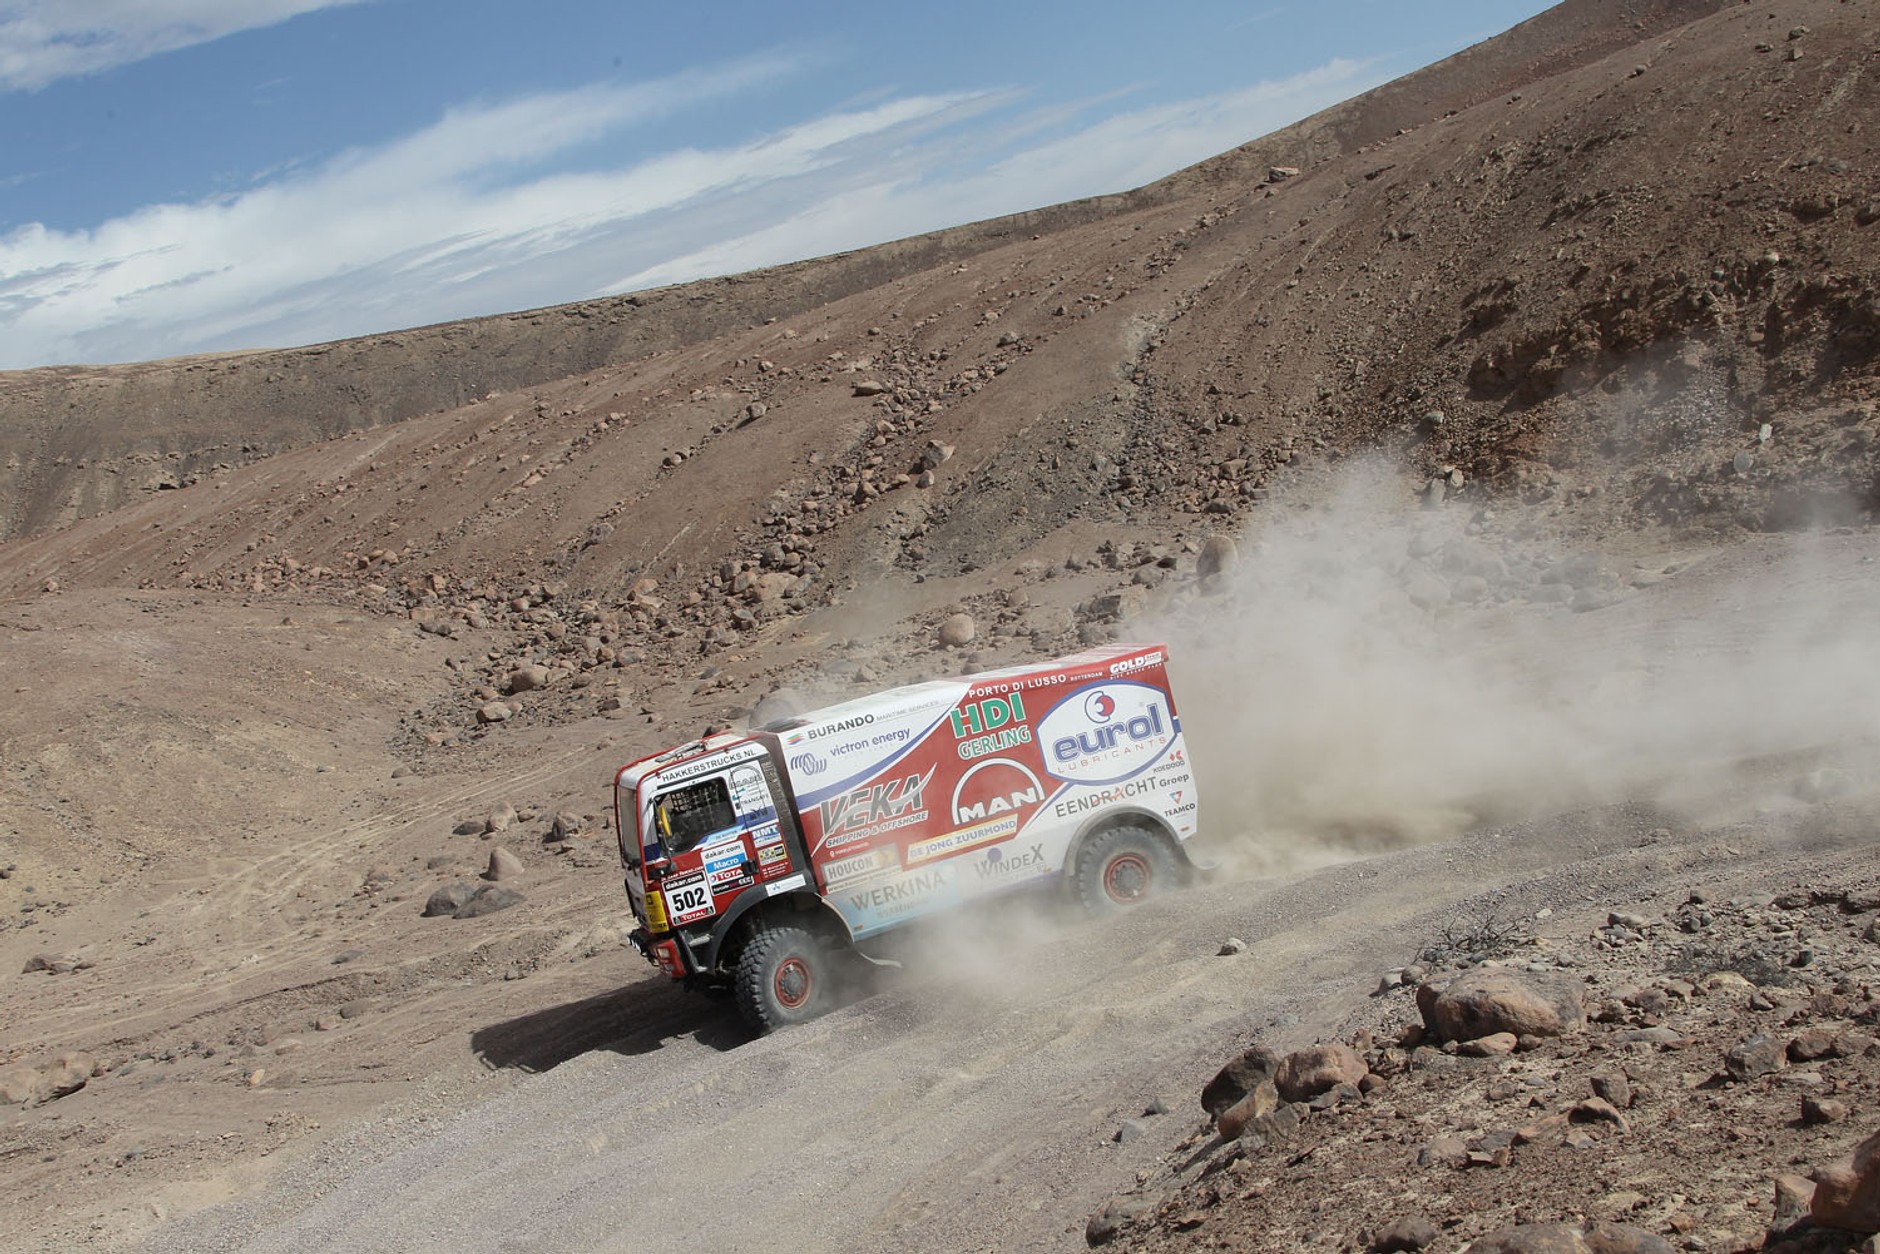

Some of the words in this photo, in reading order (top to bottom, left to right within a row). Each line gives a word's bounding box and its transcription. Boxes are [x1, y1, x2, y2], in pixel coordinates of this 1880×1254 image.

[1110, 656, 1144, 675] GOLD
[968, 683, 1009, 698] PORTO
[1012, 681, 1024, 691] DI
[1028, 673, 1067, 688] LUSSO
[807, 713, 875, 740] BURANDO
[950, 692, 1027, 739] HDI
[830, 741, 869, 757] victron
[871, 728, 911, 746] energy
[958, 724, 1032, 760] GERLING
[1053, 702, 1165, 762] eurol
[1057, 736, 1167, 773] LUBRICANTS
[1159, 774, 1190, 788] Groep
[820, 773, 923, 834] VEKA
[959, 787, 1037, 824] MAN
[1055, 777, 1158, 818] EENDRACHT
[1164, 802, 1196, 817] TEAMCO
[753, 825, 778, 839] NMT
[827, 829, 870, 847] SHIPPING
[880, 812, 928, 832] OFFSHORE
[910, 848, 922, 857] DE
[924, 839, 953, 855] JONG
[955, 820, 1016, 845] ZUURMOND
[705, 844, 741, 859] dakar.com
[713, 858, 739, 870] Macro
[718, 869, 744, 879] TOTA
[828, 856, 874, 879] HOUCON
[665, 874, 702, 889] dakar.com
[851, 872, 945, 911] WERKINA
[672, 887, 707, 912] 502
[682, 910, 707, 920] TOTAL
